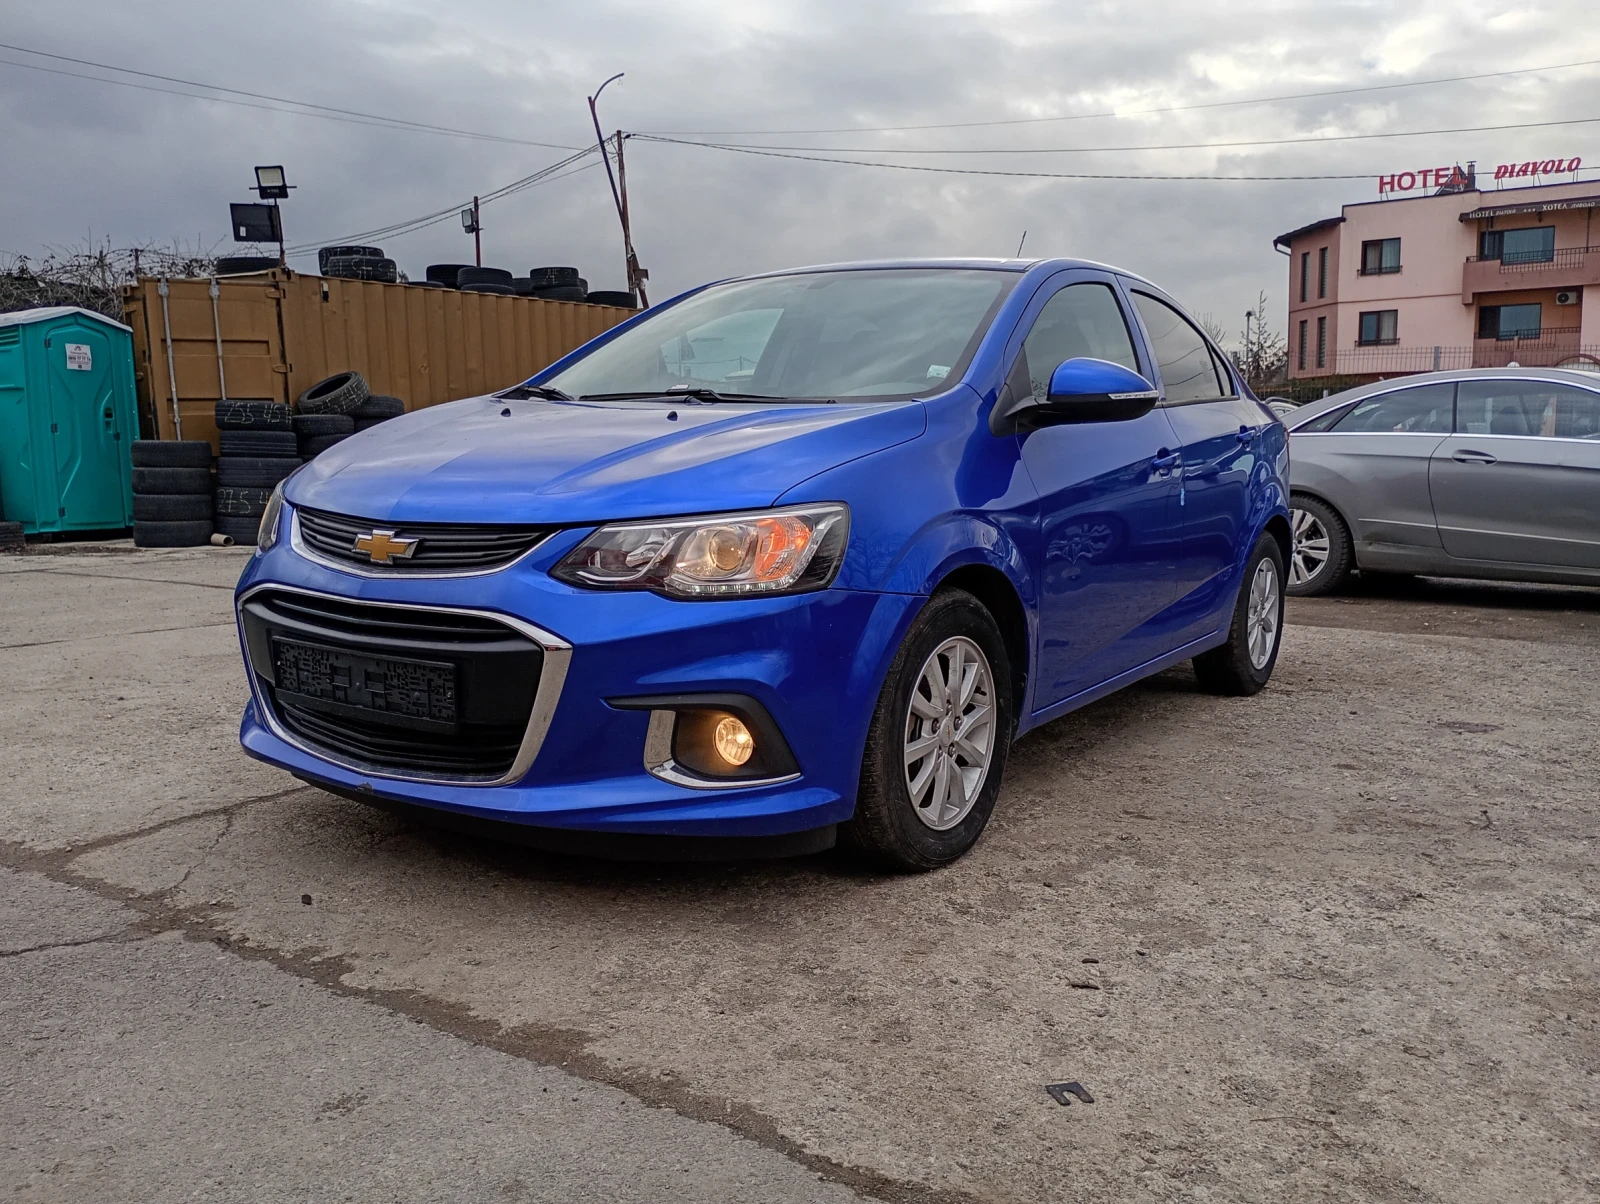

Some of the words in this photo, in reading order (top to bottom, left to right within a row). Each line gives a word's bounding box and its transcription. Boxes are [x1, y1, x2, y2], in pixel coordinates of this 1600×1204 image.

[1379, 166, 1467, 193] HOTEL
[1494, 157, 1581, 180] DIAVOLO
[1469, 210, 1495, 219] HOTEL
